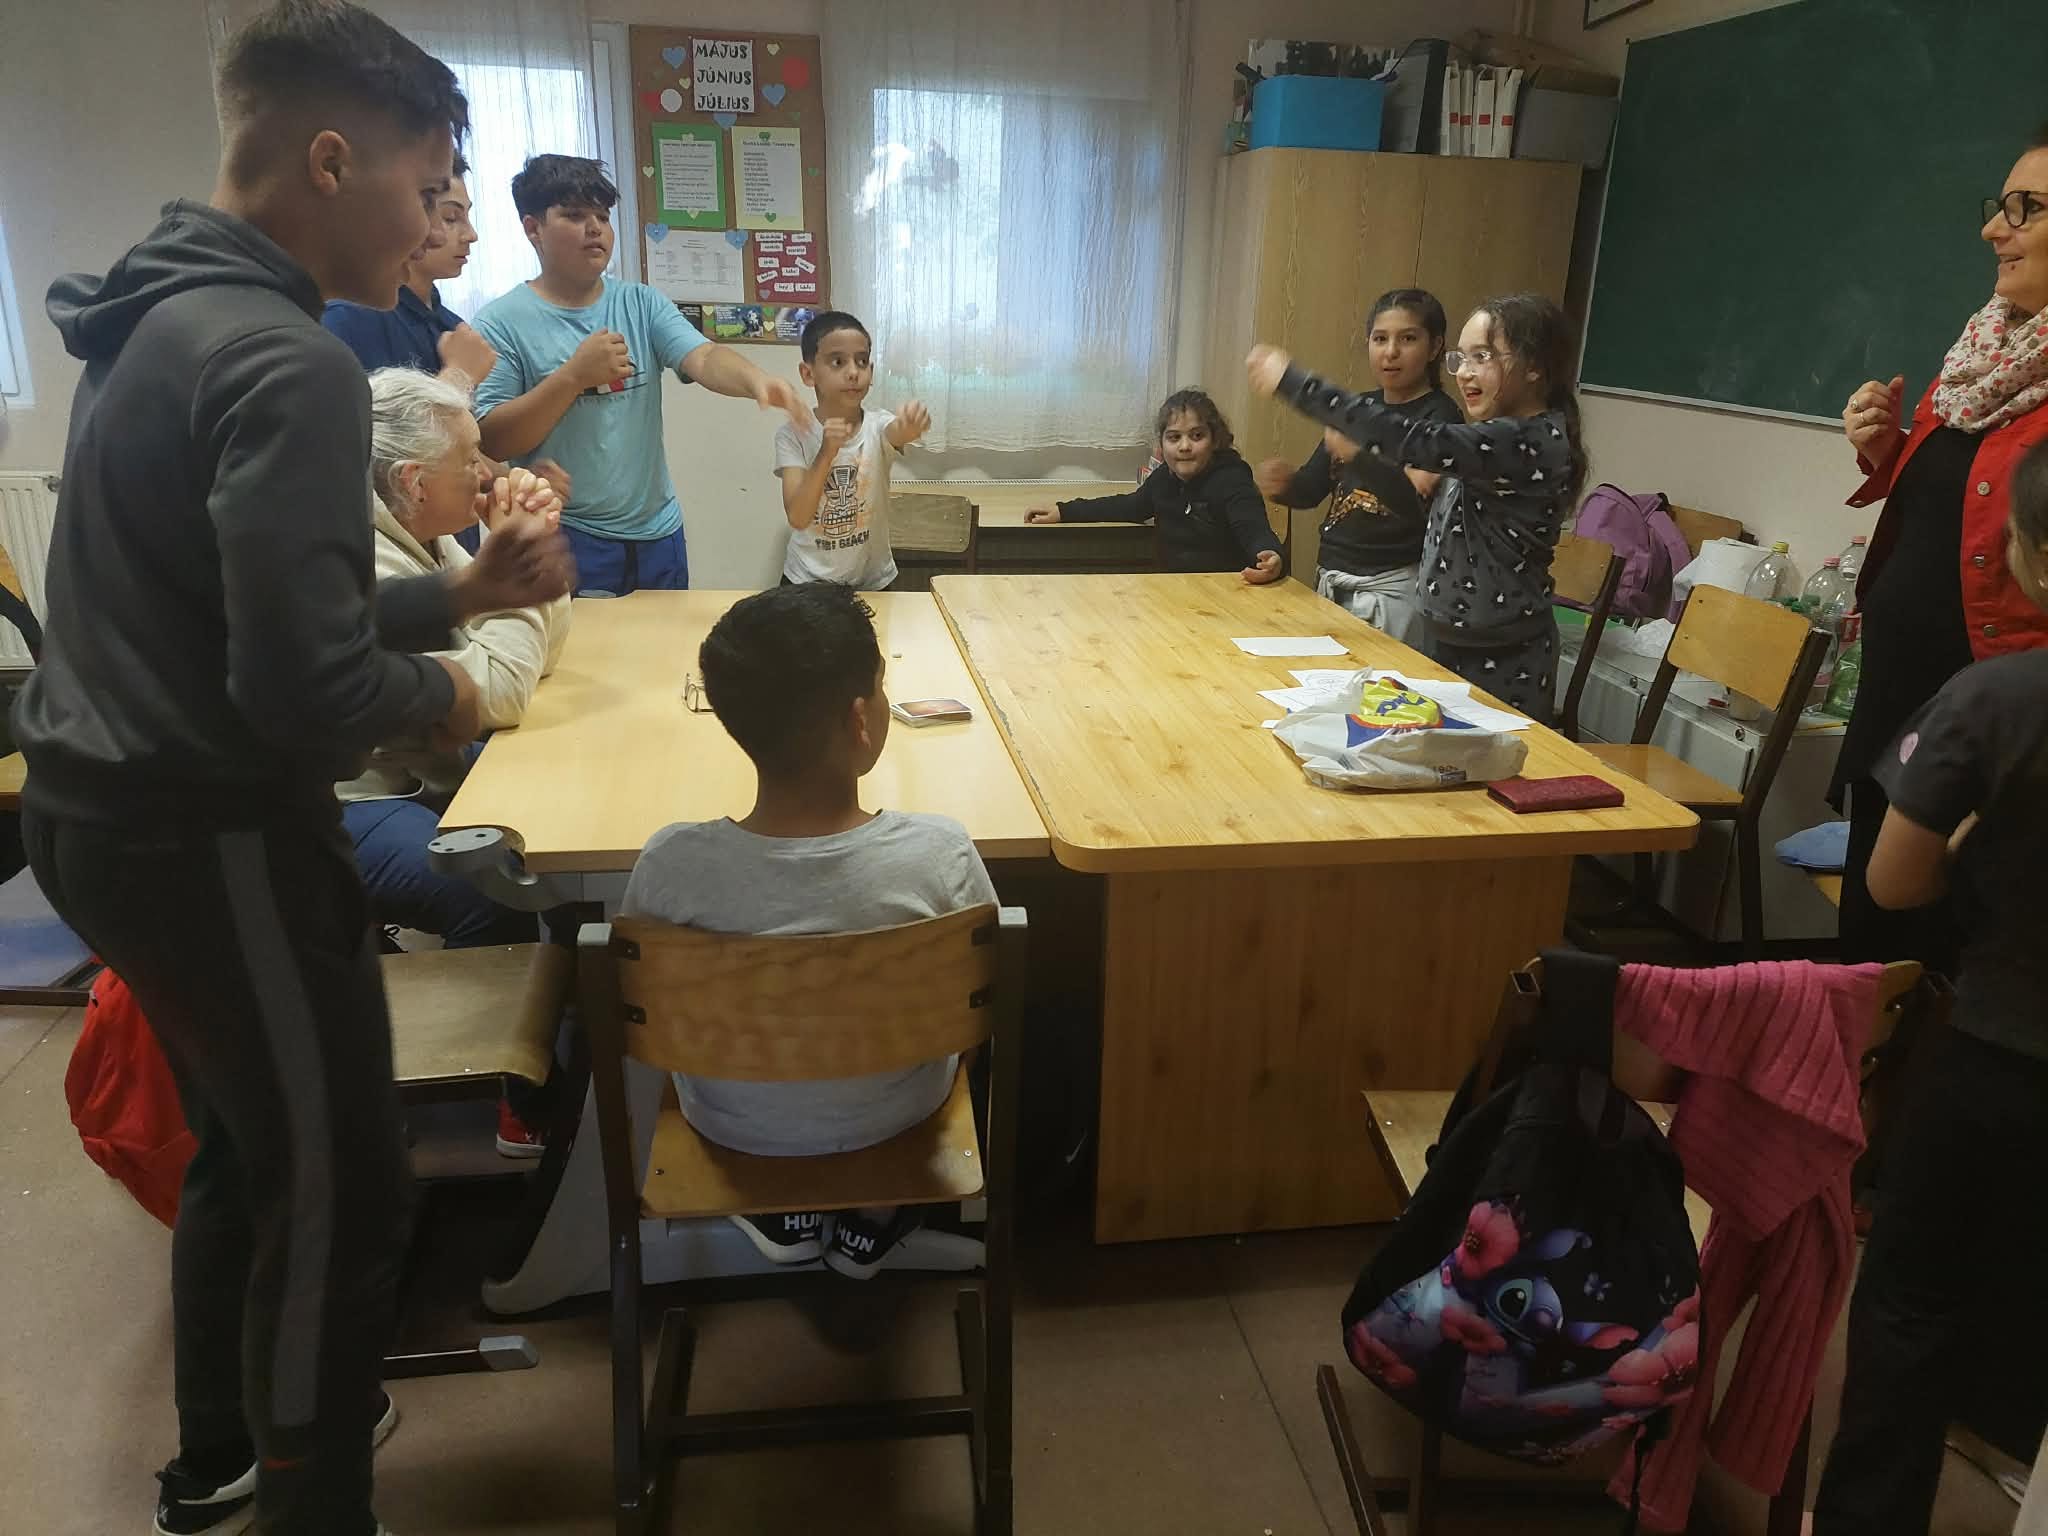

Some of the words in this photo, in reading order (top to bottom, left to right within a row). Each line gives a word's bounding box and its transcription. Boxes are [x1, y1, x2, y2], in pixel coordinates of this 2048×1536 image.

[695, 41, 748, 59] MÁJUS
[697, 66, 752, 85] JÚNIUS
[697, 92, 750, 110] JÚLIUS
